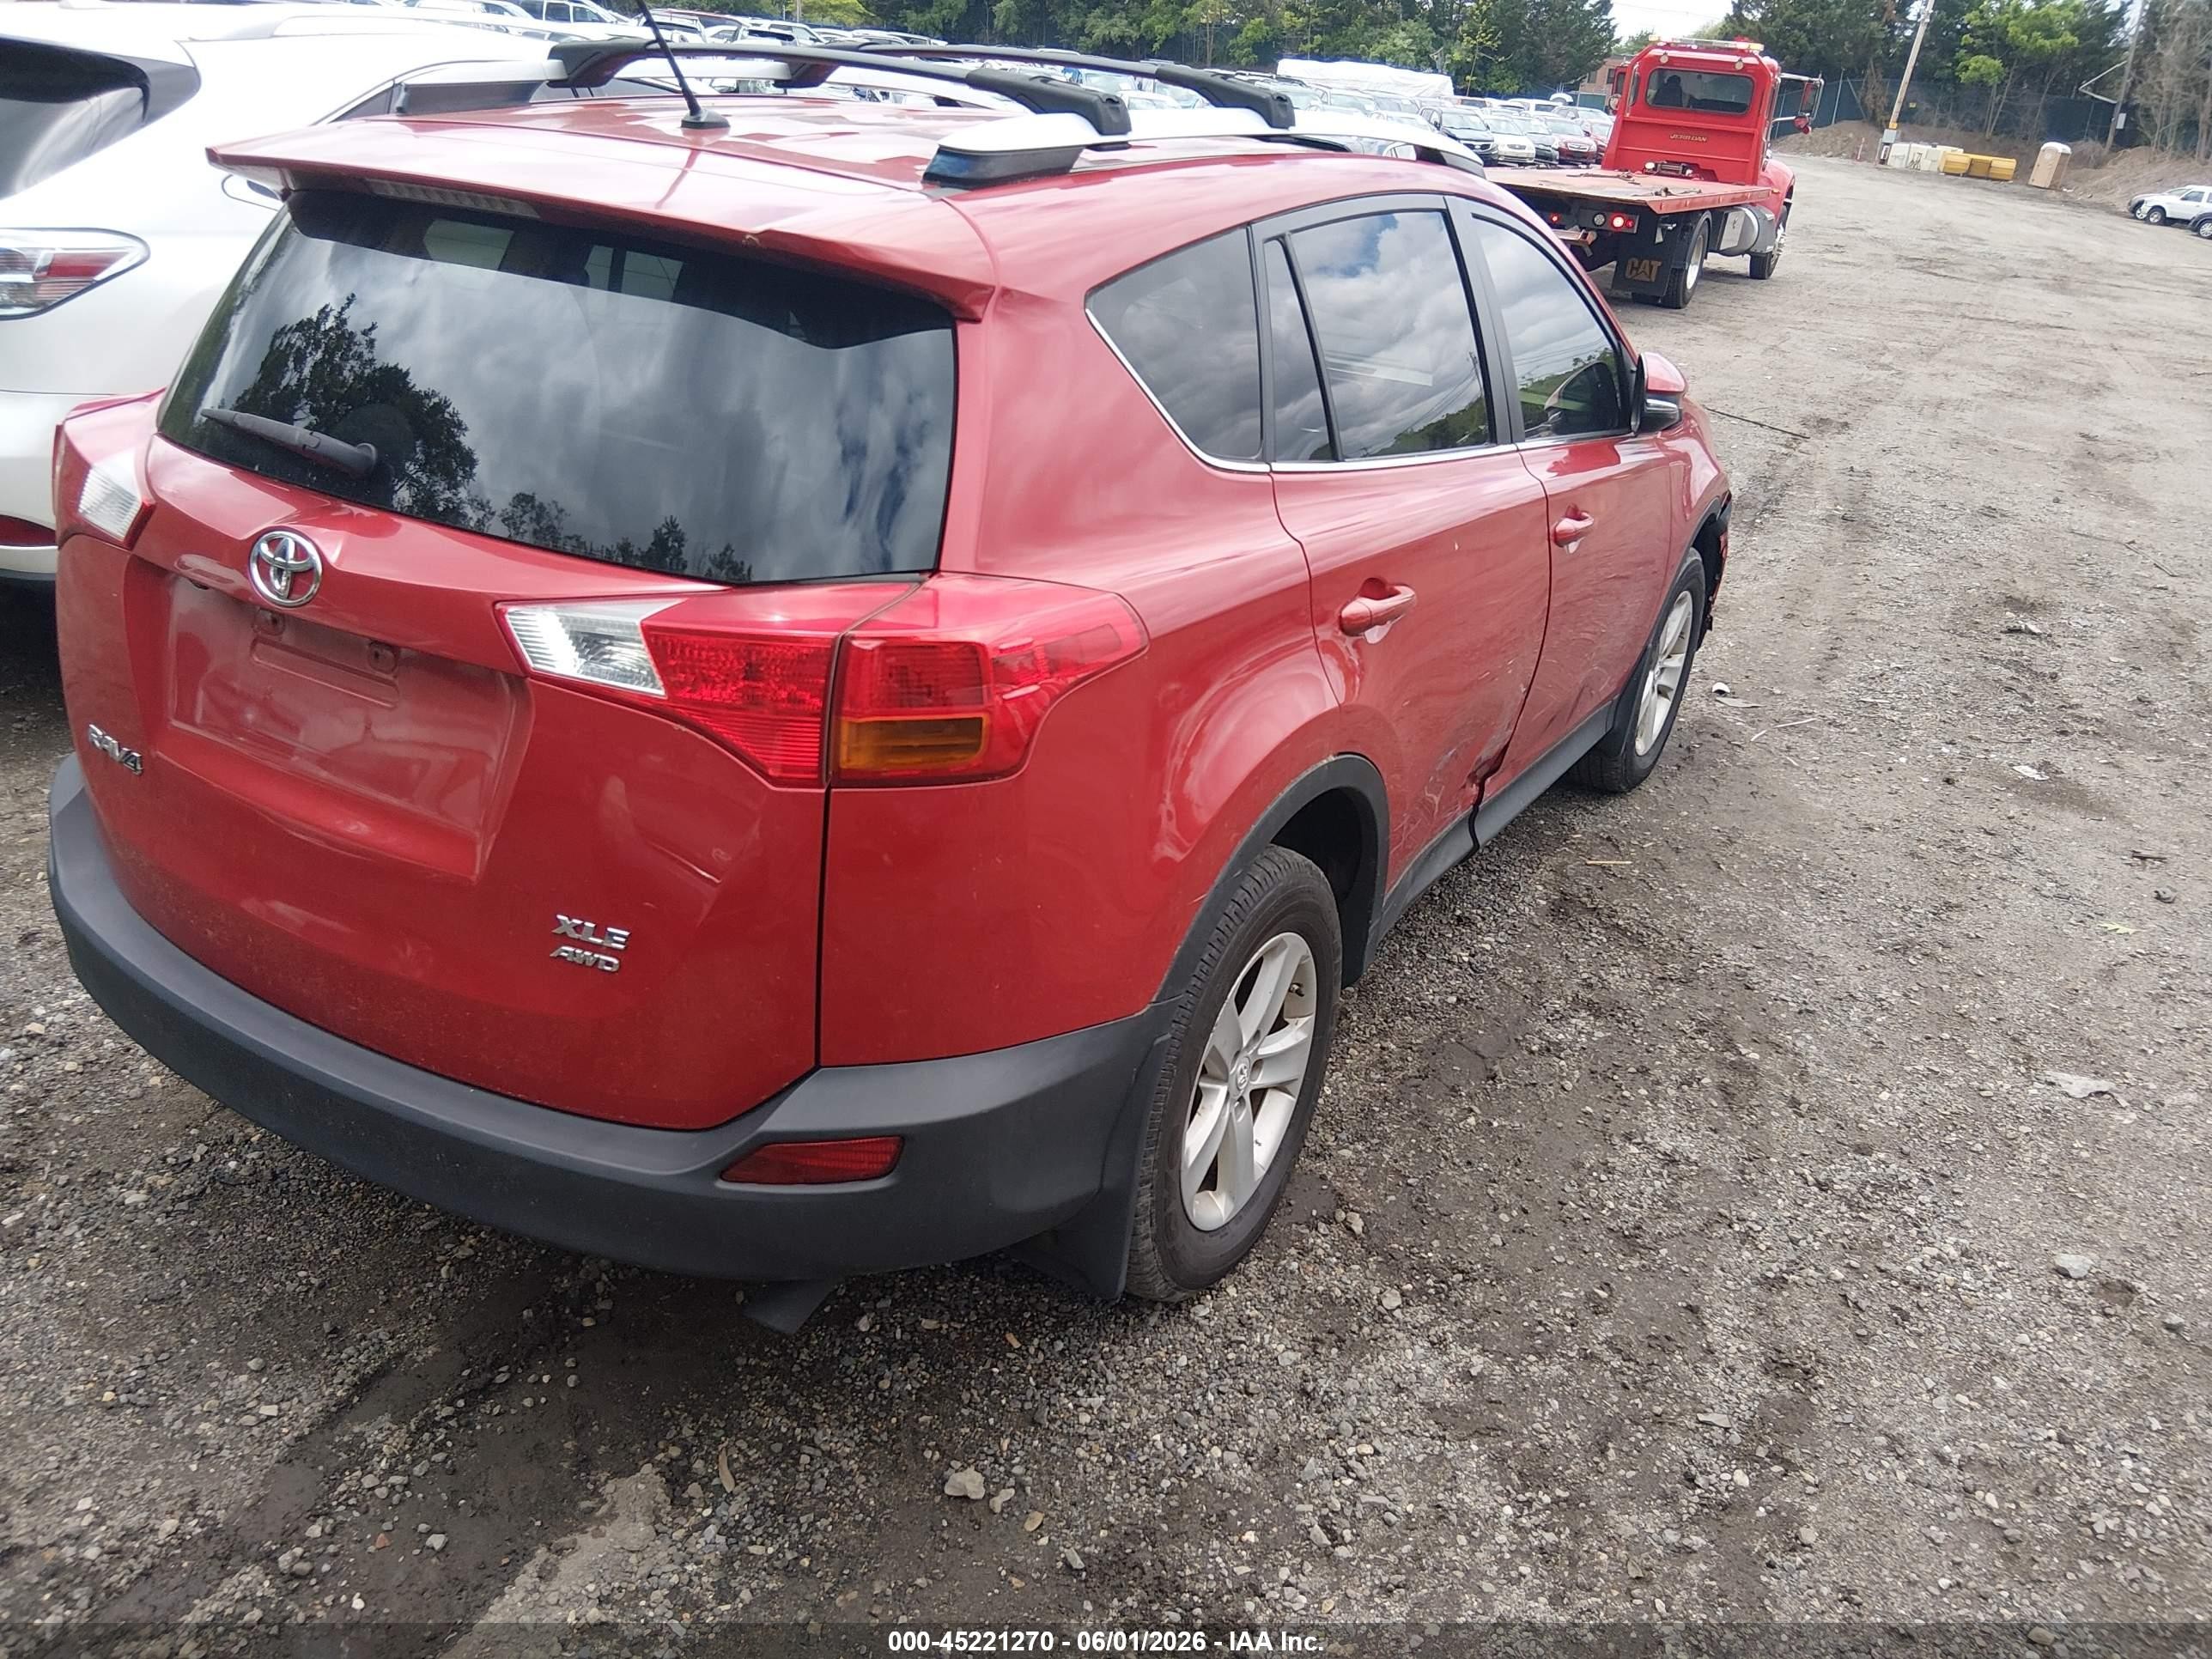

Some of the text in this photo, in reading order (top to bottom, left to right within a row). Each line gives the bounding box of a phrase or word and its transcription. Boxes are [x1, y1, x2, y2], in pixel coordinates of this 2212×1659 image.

[1625, 258, 1662, 283] CAT
[88, 723, 143, 775] RAV4
[550, 914, 631, 951] XLE
[549, 945, 621, 973] AWD
